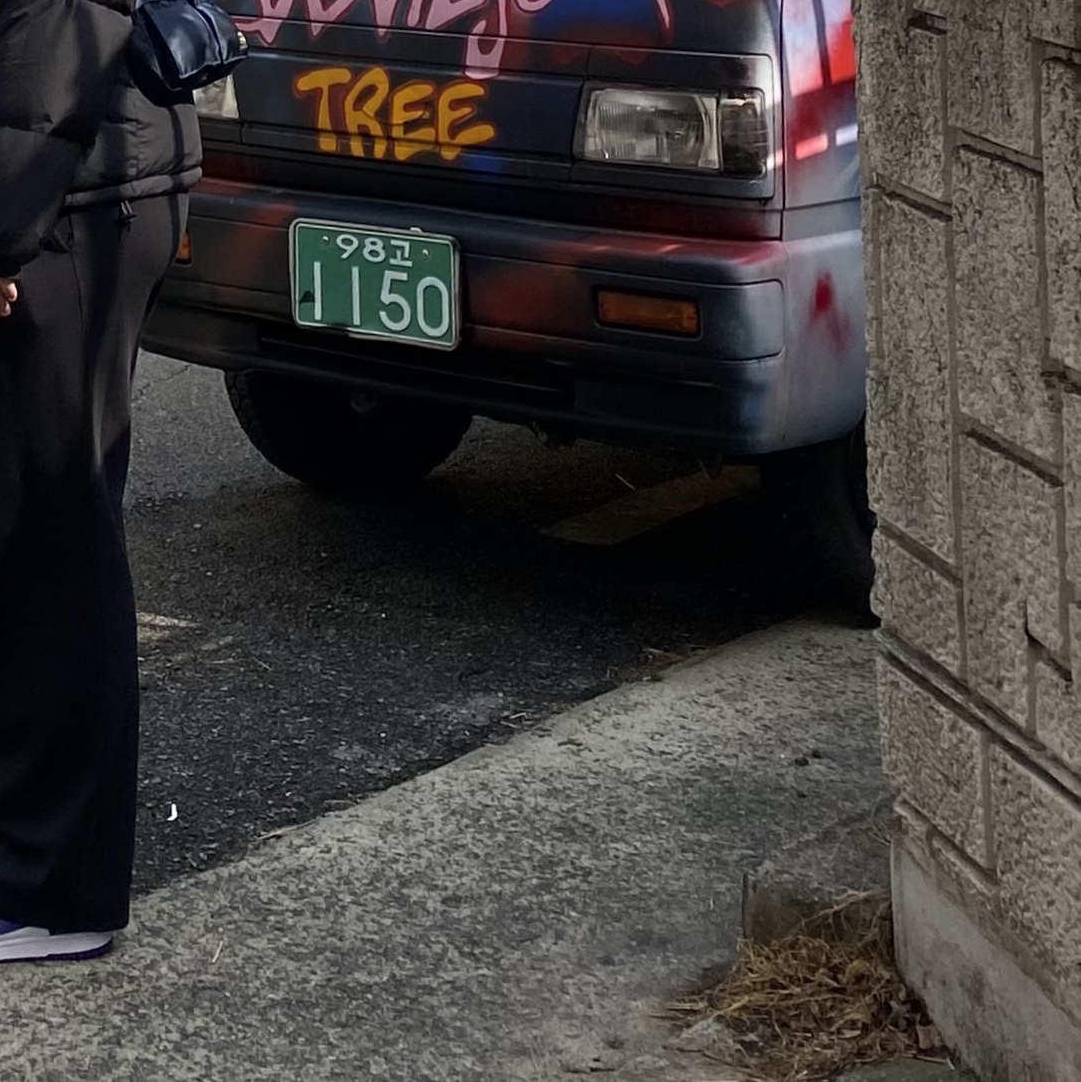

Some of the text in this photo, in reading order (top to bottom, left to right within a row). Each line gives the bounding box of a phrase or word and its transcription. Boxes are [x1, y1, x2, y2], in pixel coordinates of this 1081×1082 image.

[296, 68, 495, 161] TREE
[336, 234, 413, 267] 98고
[313, 261, 450, 338] 1150
